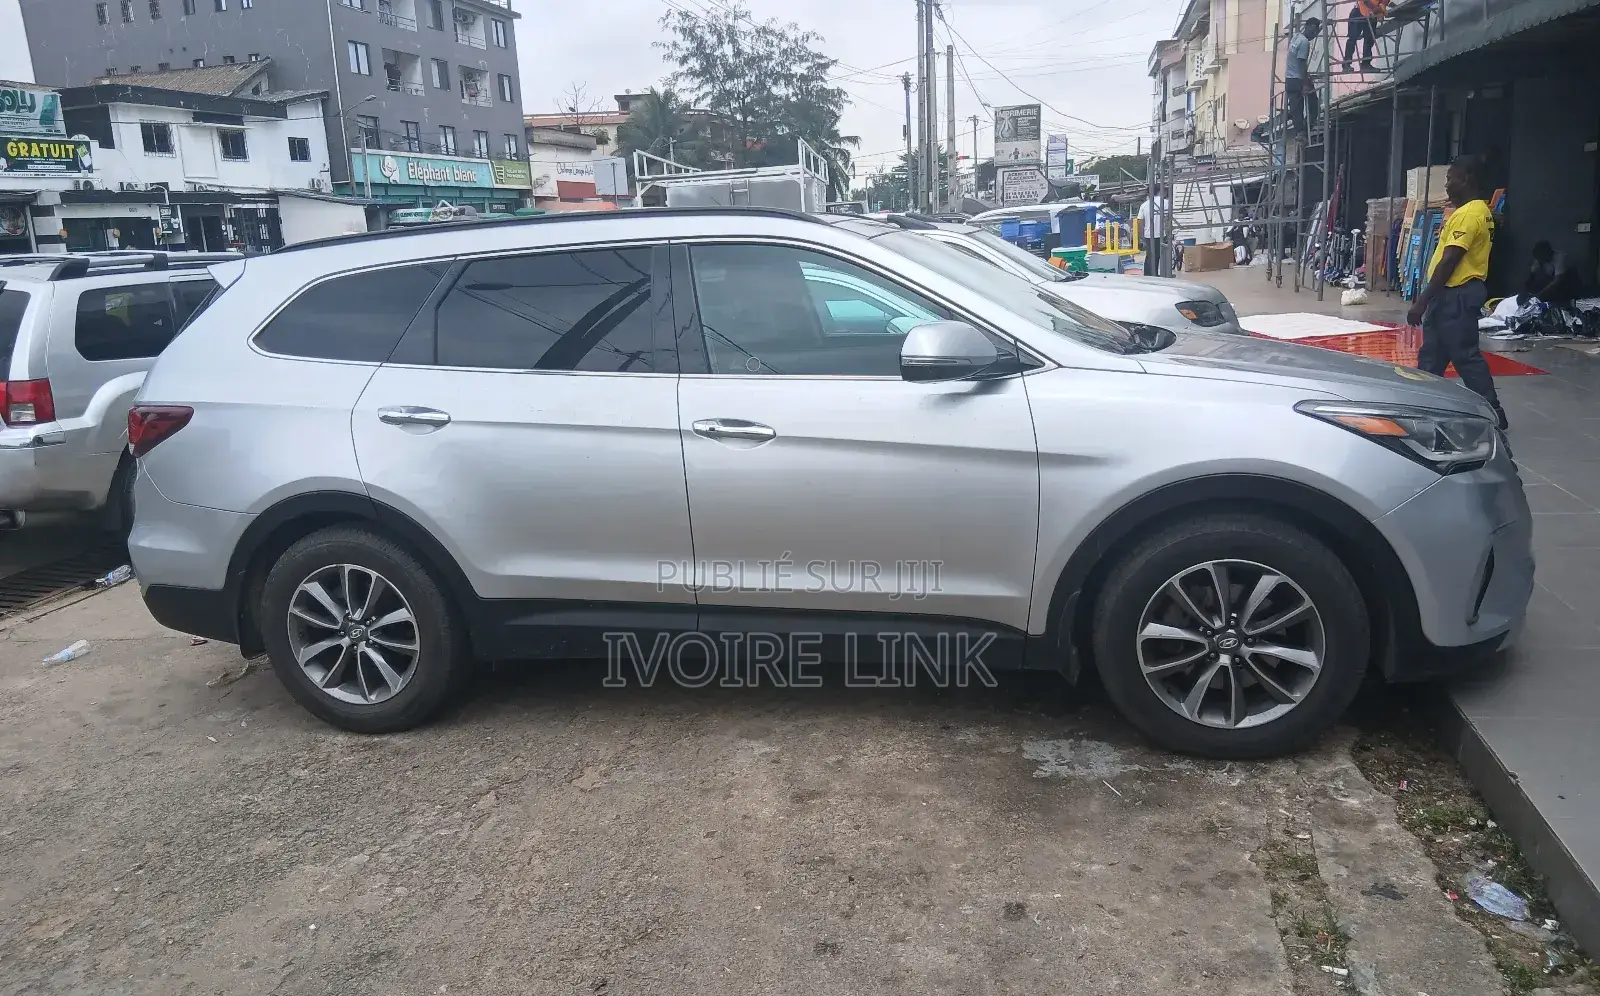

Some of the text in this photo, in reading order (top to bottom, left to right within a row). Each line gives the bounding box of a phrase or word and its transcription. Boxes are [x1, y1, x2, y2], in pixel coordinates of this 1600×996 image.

[7, 141, 74, 158] GRATUIT
[408, 157, 478, 185] Éléphant blanc
